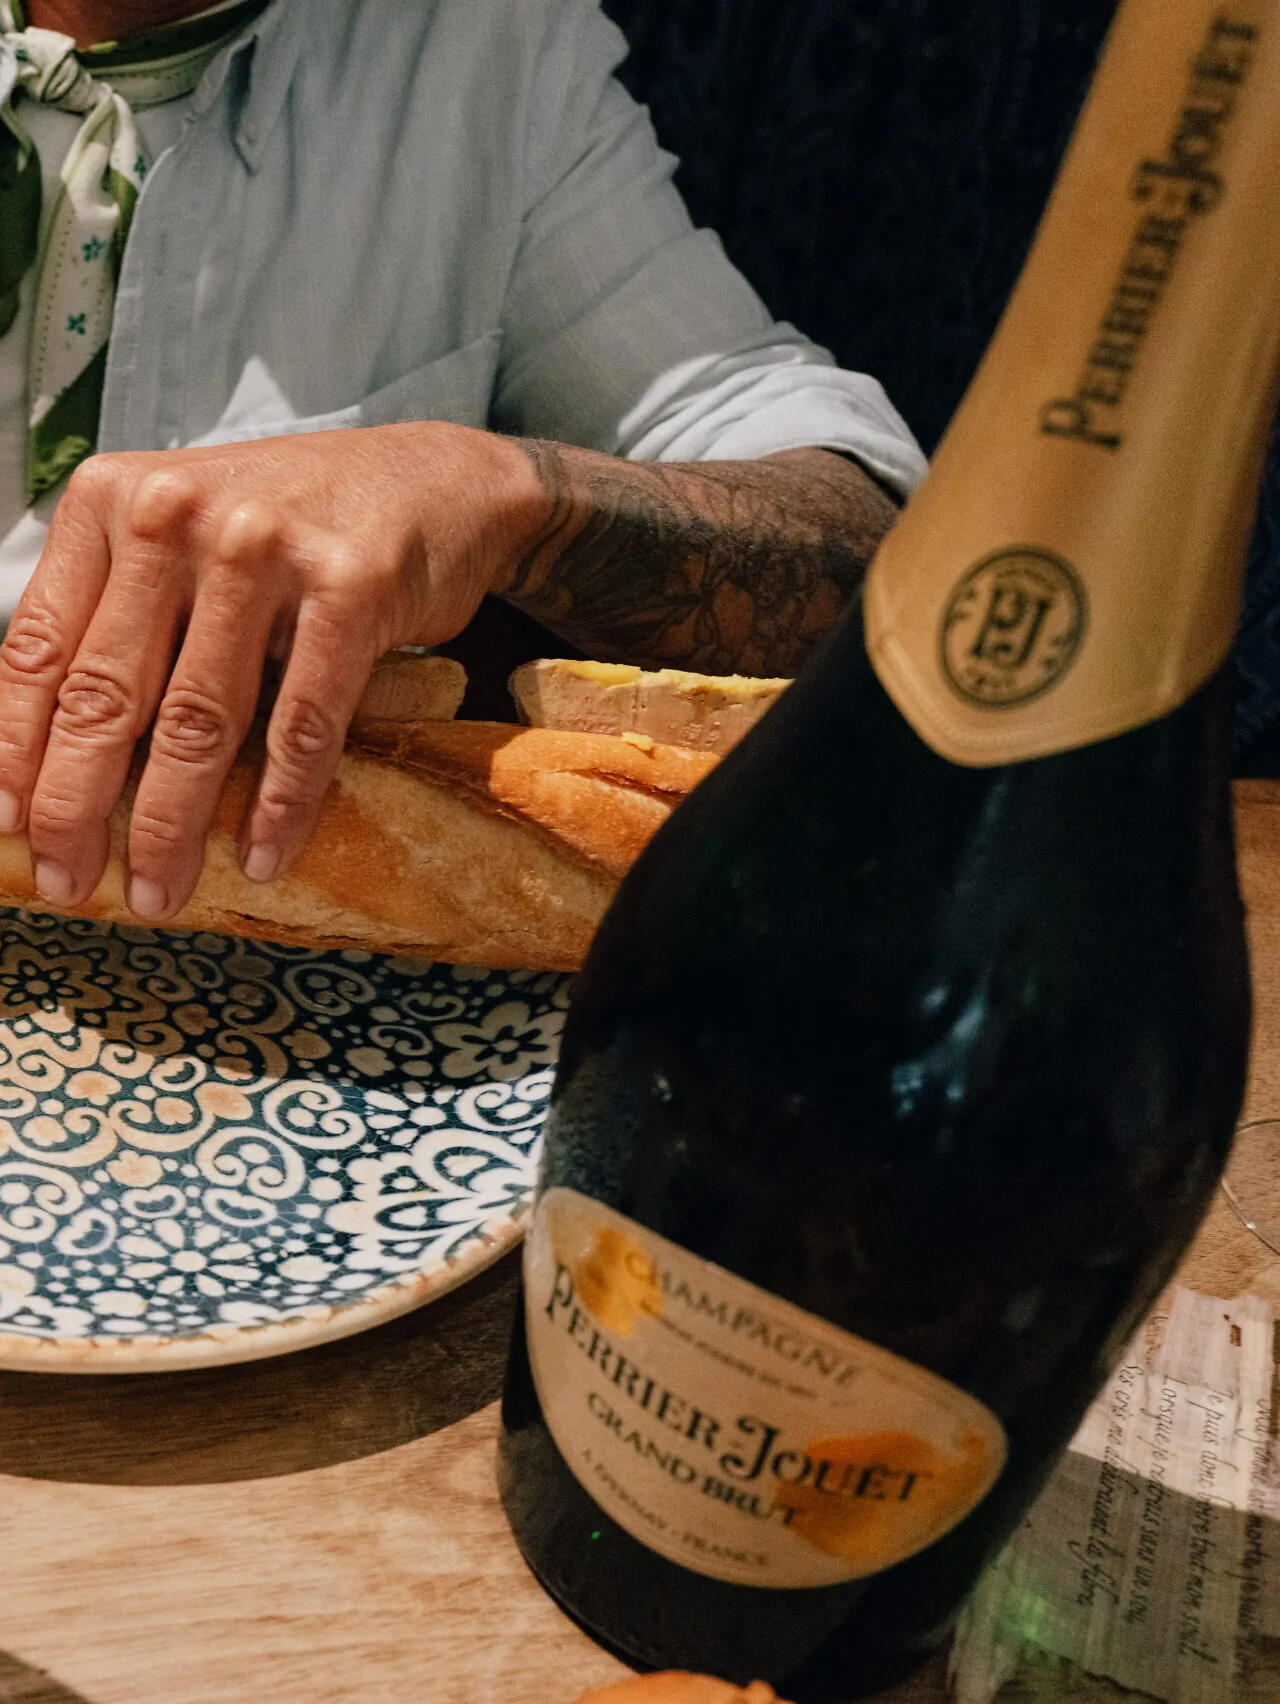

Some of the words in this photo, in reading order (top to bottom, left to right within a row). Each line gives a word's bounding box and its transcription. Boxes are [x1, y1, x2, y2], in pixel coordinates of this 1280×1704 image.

[624, 1249, 858, 1386] CHAMPAGNE
[587, 1391, 697, 1484] GRAND
[700, 1474, 807, 1526] BRUT
[1186, 1400, 1227, 1446] puis
